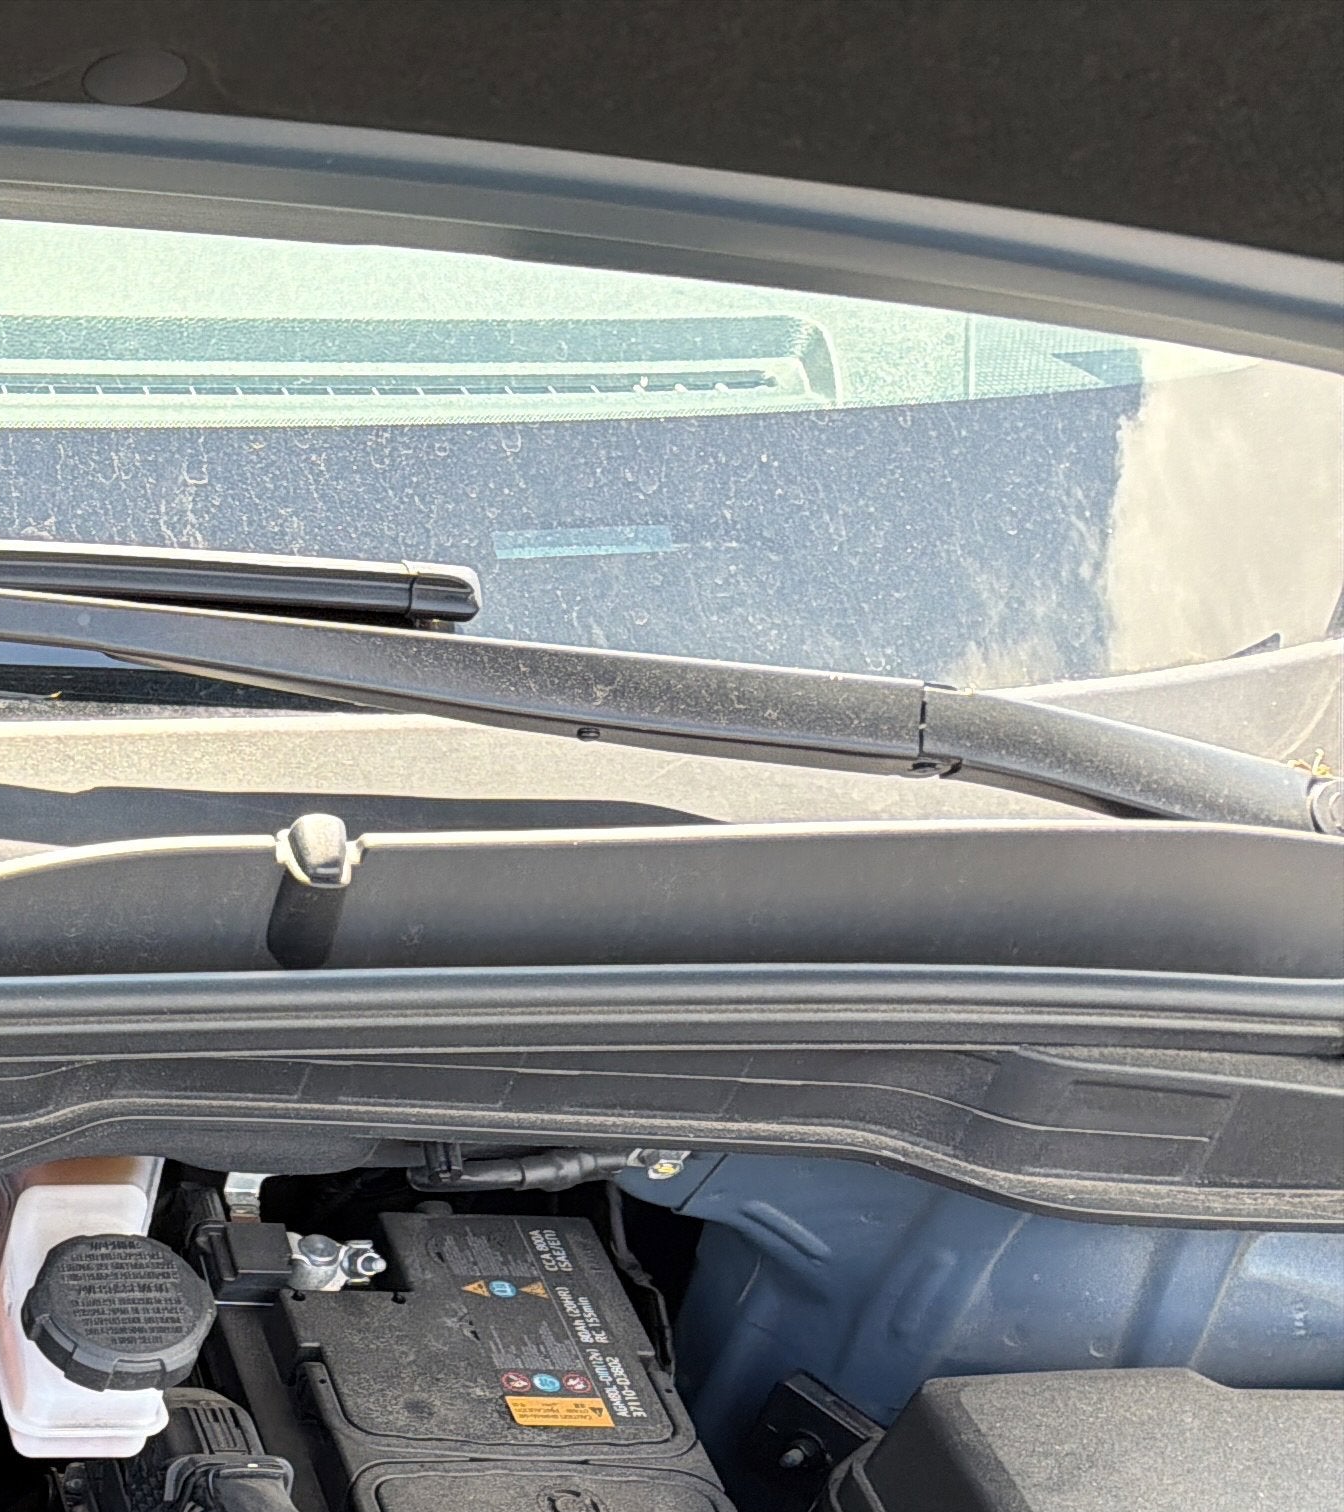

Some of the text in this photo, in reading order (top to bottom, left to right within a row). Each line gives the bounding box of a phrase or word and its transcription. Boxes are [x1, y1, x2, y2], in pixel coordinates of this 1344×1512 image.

[529, 1229, 559, 1272] CCA 800A
[555, 1286, 595, 1344] 80Ah (20HR)
[577, 1296, 602, 1328] 155min
[592, 1329, 609, 1344] RC
